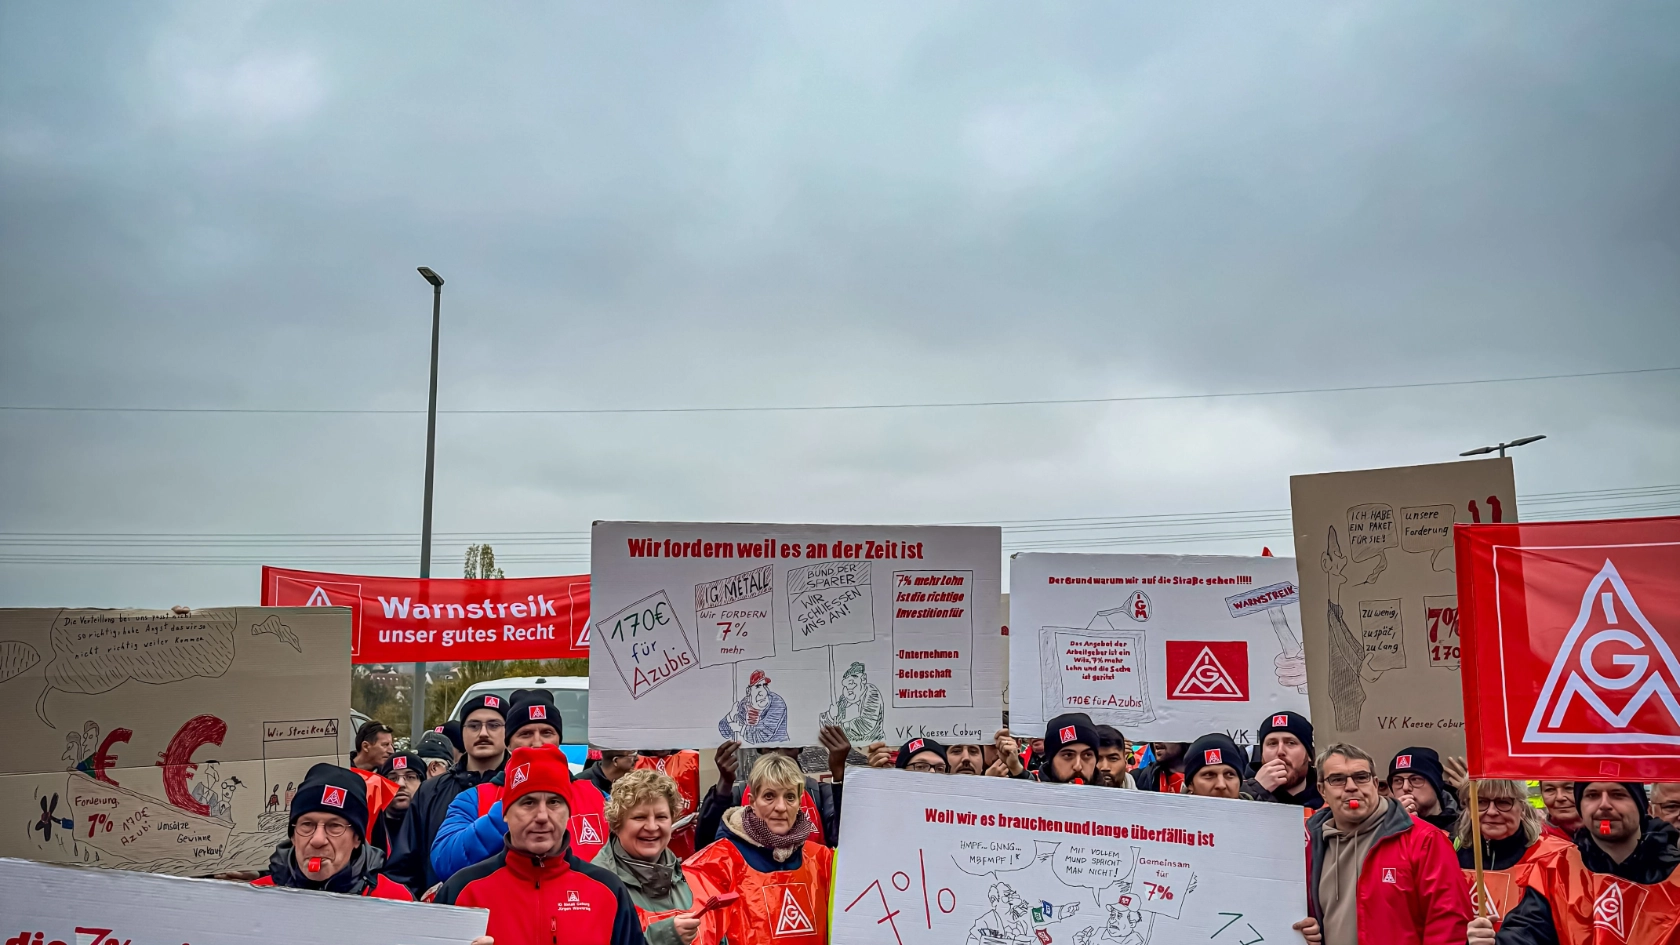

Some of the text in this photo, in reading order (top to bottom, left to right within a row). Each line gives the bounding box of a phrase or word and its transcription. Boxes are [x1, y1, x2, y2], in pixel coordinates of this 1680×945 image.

[1351, 509, 1391, 521] ICH HABE
[1404, 511, 1439, 520] unsere
[1350, 521, 1392, 532] EIN PAKET
[1405, 525, 1449, 537] Forderung
[1351, 534, 1367, 544] FÜR
[628, 537, 924, 559] Wir fordern weil es an der Zeit ist
[807, 563, 857, 579] BUND DER
[705, 570, 770, 603] IG METALL
[806, 574, 856, 588] SPARER
[896, 574, 964, 588] 7% mehr Lohn
[1048, 576, 1065, 584] Der
[1065, 576, 1093, 585] Grund
[1093, 577, 1125, 585] warum
[1125, 576, 1139, 585] wir
[1141, 575, 1156, 585] auf
[1157, 576, 1171, 584] die
[1206, 576, 1235, 586] gehen
[801, 594, 825, 609] WIR
[896, 591, 965, 603] ist die richtige
[1233, 585, 1295, 609] WARNSTREIK
[377, 594, 557, 619] Warnstreik
[797, 586, 861, 623] SCHLIESSEN
[64, 617, 77, 626] Die
[119, 613, 130, 622] bei
[152, 612, 169, 621] passt
[700, 610, 768, 619] Wir FORDERN
[801, 603, 851, 636] UNS AN!
[896, 607, 964, 618] Investition für
[145, 622, 168, 634] Angst
[611, 601, 670, 642] 170€
[378, 623, 555, 647] unser gutes Recht
[717, 621, 748, 641] 7%
[74, 645, 99, 659] nicht
[107, 641, 138, 653] richtig
[720, 646, 745, 655] mehr
[1083, 640, 1113, 648] Angebot
[631, 641, 657, 664] für
[1066, 648, 1107, 657] Arbeitgeber
[633, 647, 690, 694] Azubis
[1109, 665, 1131, 673] Sache
[1066, 694, 1142, 708] 170€ für Azubis
[1377, 716, 1465, 729] VK Kaeser Cobur
[267, 727, 284, 738] Wir
[895, 725, 913, 738] VK
[953, 723, 982, 741] Coburg
[1226, 729, 1250, 744] VK
[88, 812, 113, 838] 7%
[157, 821, 190, 831] Umsätze
[924, 808, 1215, 847] Weil wir es brauchen und lange überfällig ist
[121, 820, 151, 846] Azubi
[177, 831, 212, 843] Gewinne
[193, 844, 223, 858] Verkauf
[1070, 845, 1120, 859] MIT VOLLEM
[1064, 855, 1123, 866] MUND SPRICHT
[1139, 856, 1190, 868] Gemeinsam
[1065, 865, 1119, 878] MAN NICHT!
[1156, 869, 1169, 878] für
[1143, 881, 1174, 901] 7%
